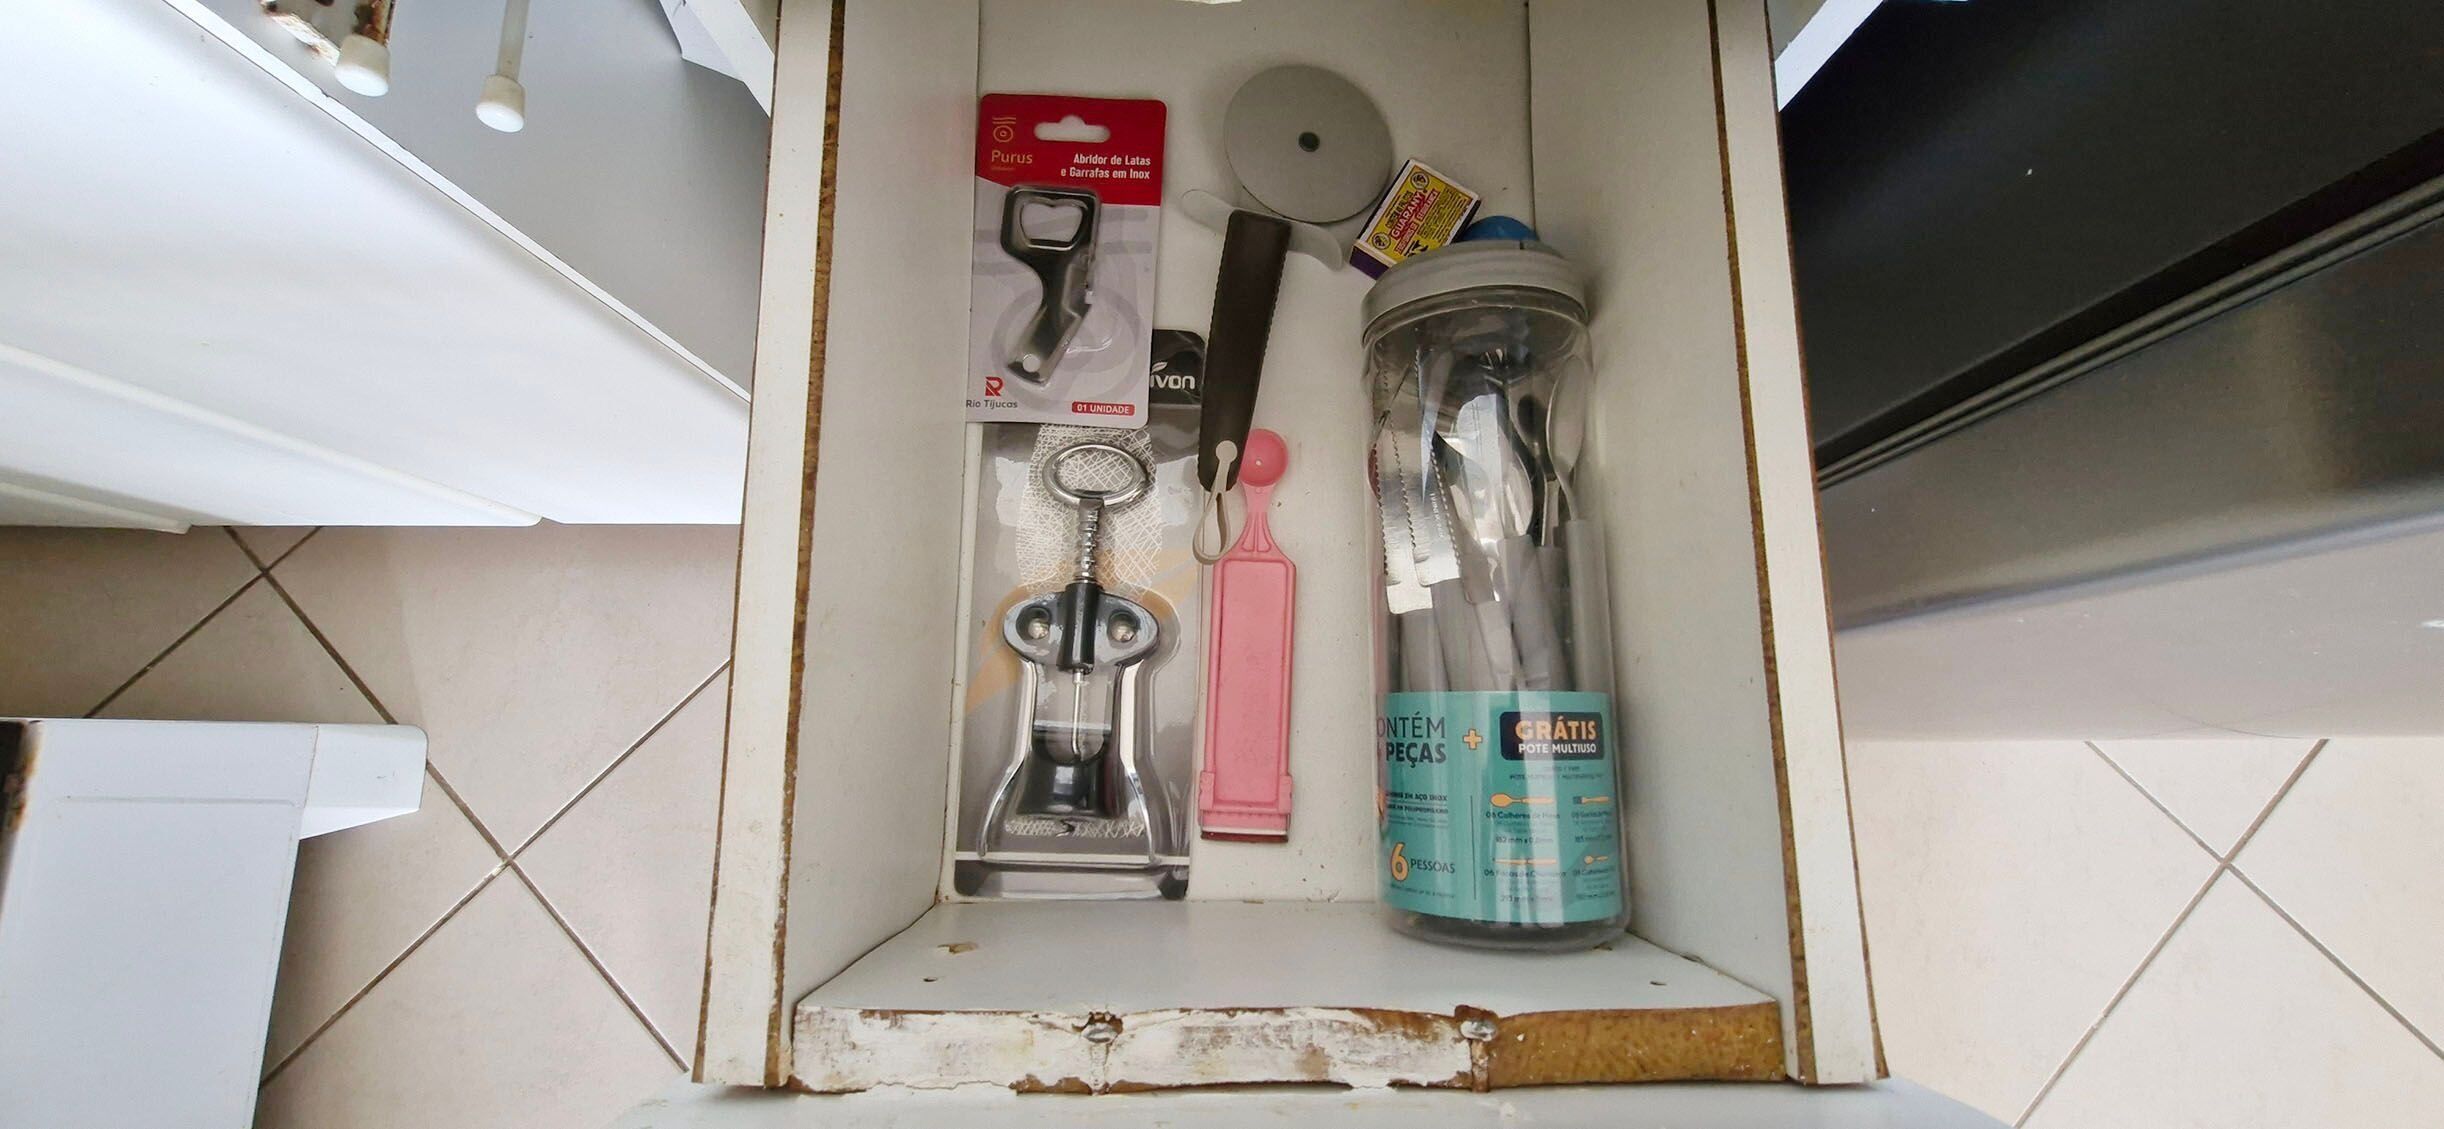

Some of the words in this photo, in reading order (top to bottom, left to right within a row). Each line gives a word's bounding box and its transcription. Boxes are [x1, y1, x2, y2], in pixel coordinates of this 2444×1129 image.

[991, 150, 1033, 164] Purus
[1073, 153, 1107, 164] Abridor
[1110, 155, 1122, 165] de
[1125, 155, 1151, 166] Latas
[1060, 169, 1067, 177] e
[1069, 167, 1110, 178] Garrafas
[1112, 169, 1127, 179] em
[1129, 168, 1151, 179] Inox
[1390, 191, 1424, 238] GUARANY
[1150, 374, 1195, 390] ivon
[965, 399, 981, 408] Rio
[984, 399, 1018, 410] Tijucas
[1076, 404, 1087, 412] 01
[1090, 404, 1129, 414] UNIDADE
[1376, 711, 1446, 738] ONTÉM
[1515, 716, 1597, 740] GRÁTIS
[1386, 742, 1447, 768] PEÇAS
[1518, 743, 1549, 754] POTE
[1552, 743, 1597, 754] MULTIUSO
[1391, 842, 1409, 882] 6
[1410, 859, 1455, 874] PESSOAS
